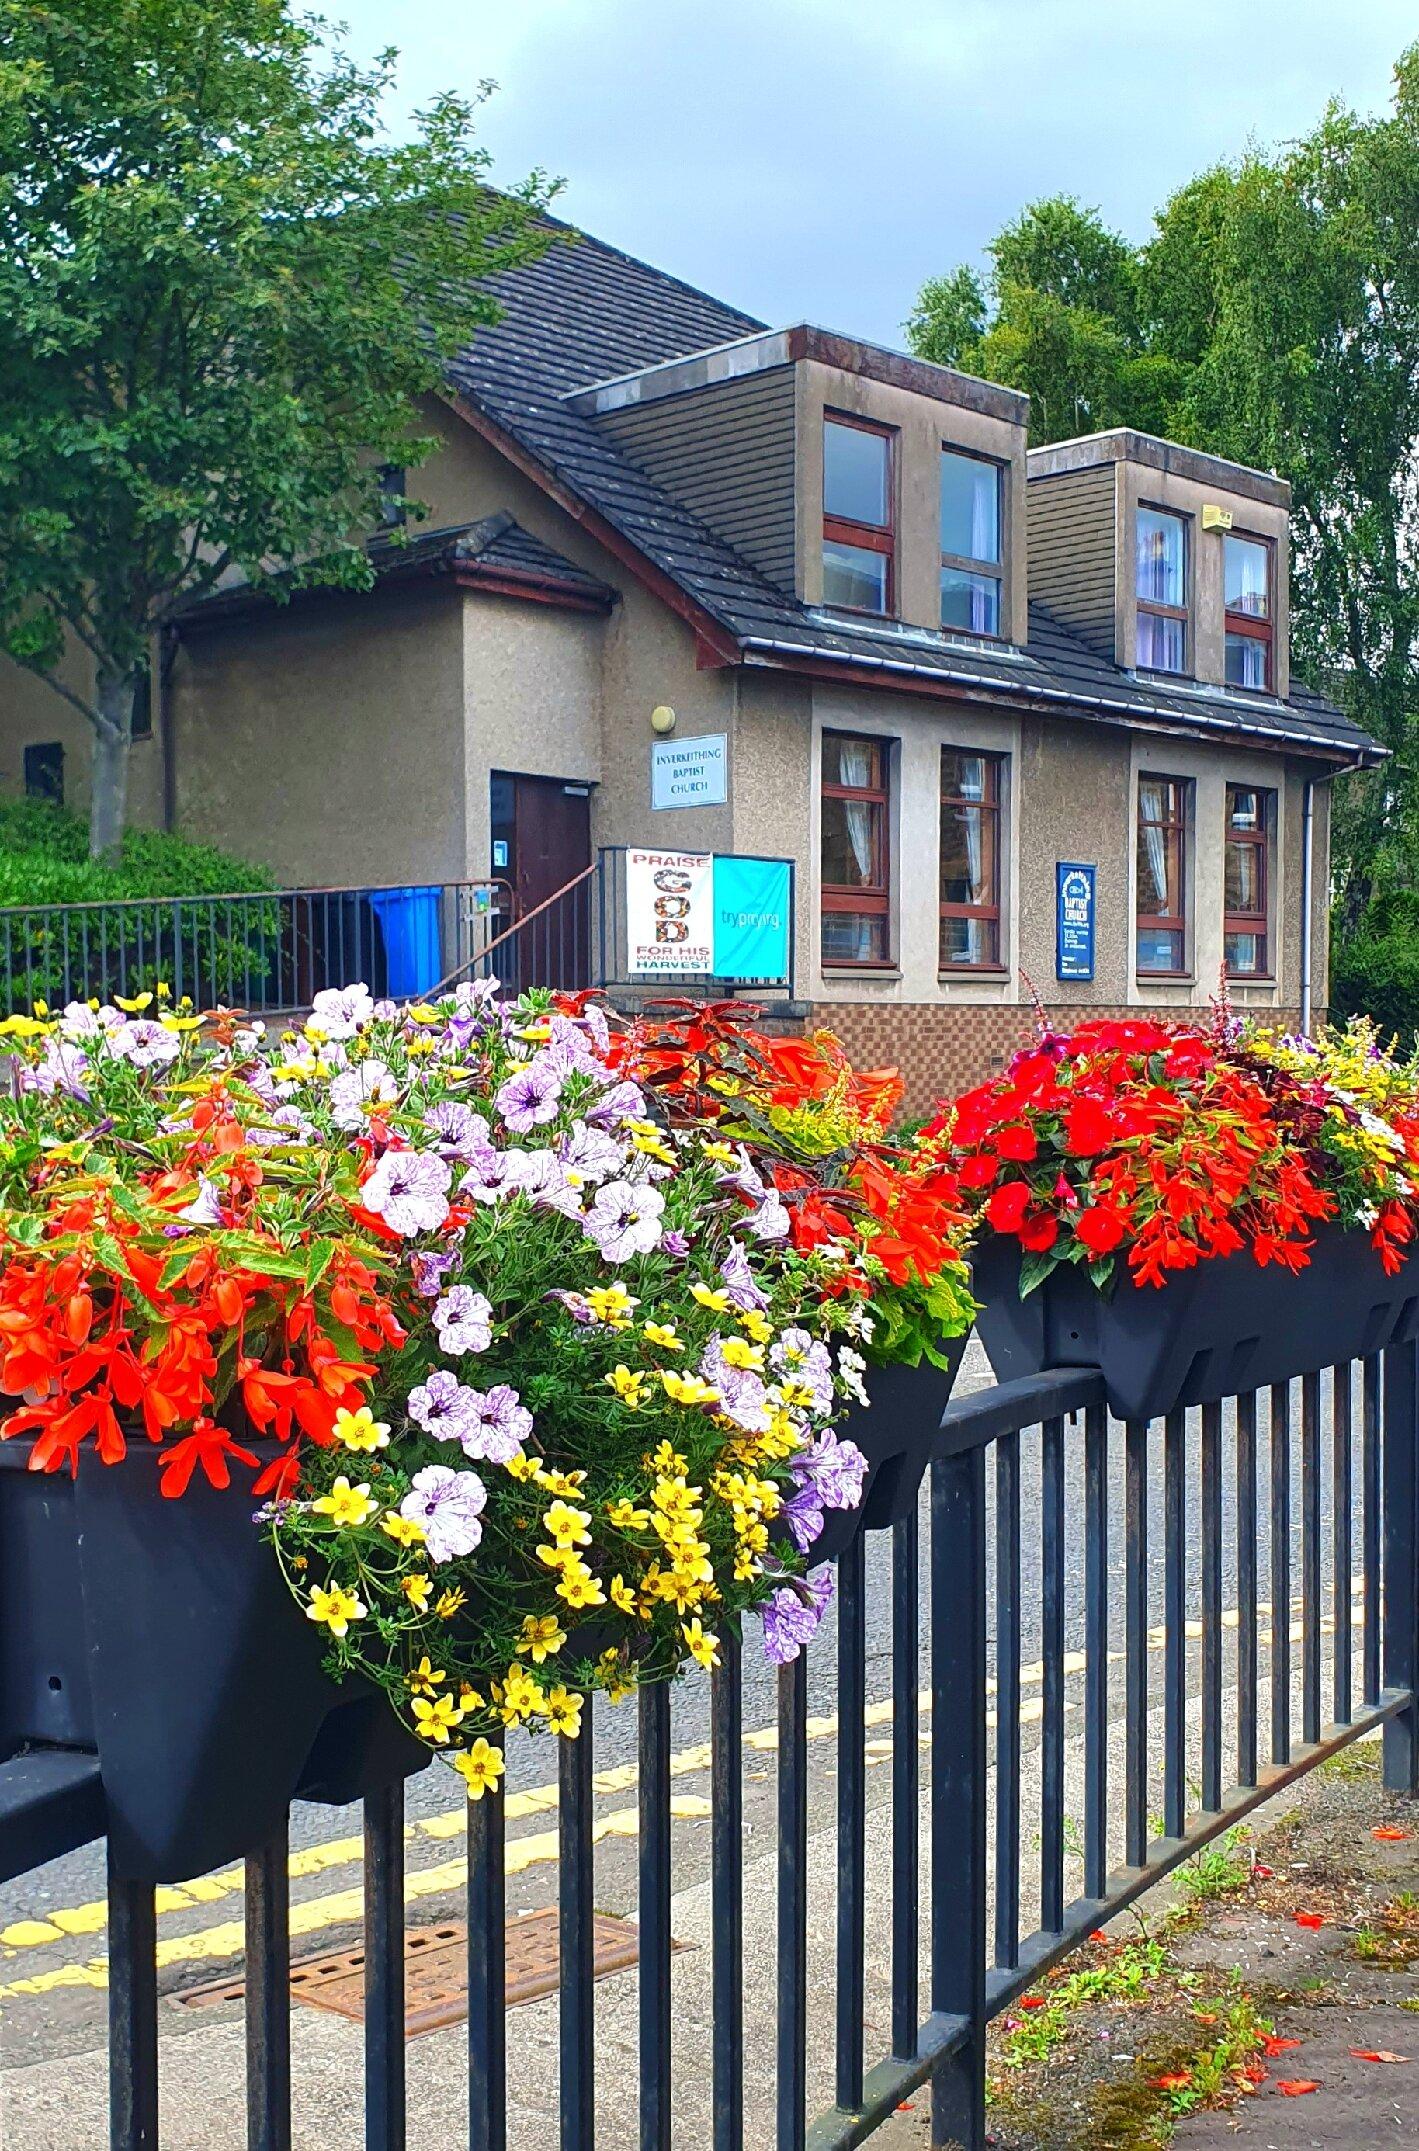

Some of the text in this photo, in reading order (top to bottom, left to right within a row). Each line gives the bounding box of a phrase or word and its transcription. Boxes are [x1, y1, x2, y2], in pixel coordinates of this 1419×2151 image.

[673, 766, 704, 779] BAPTIST
[671, 781, 708, 794] CHURCH
[632, 854, 710, 868] PRAISE
[636, 945, 710, 955] FOR HIS
[636, 961, 711, 969] HARVEST
